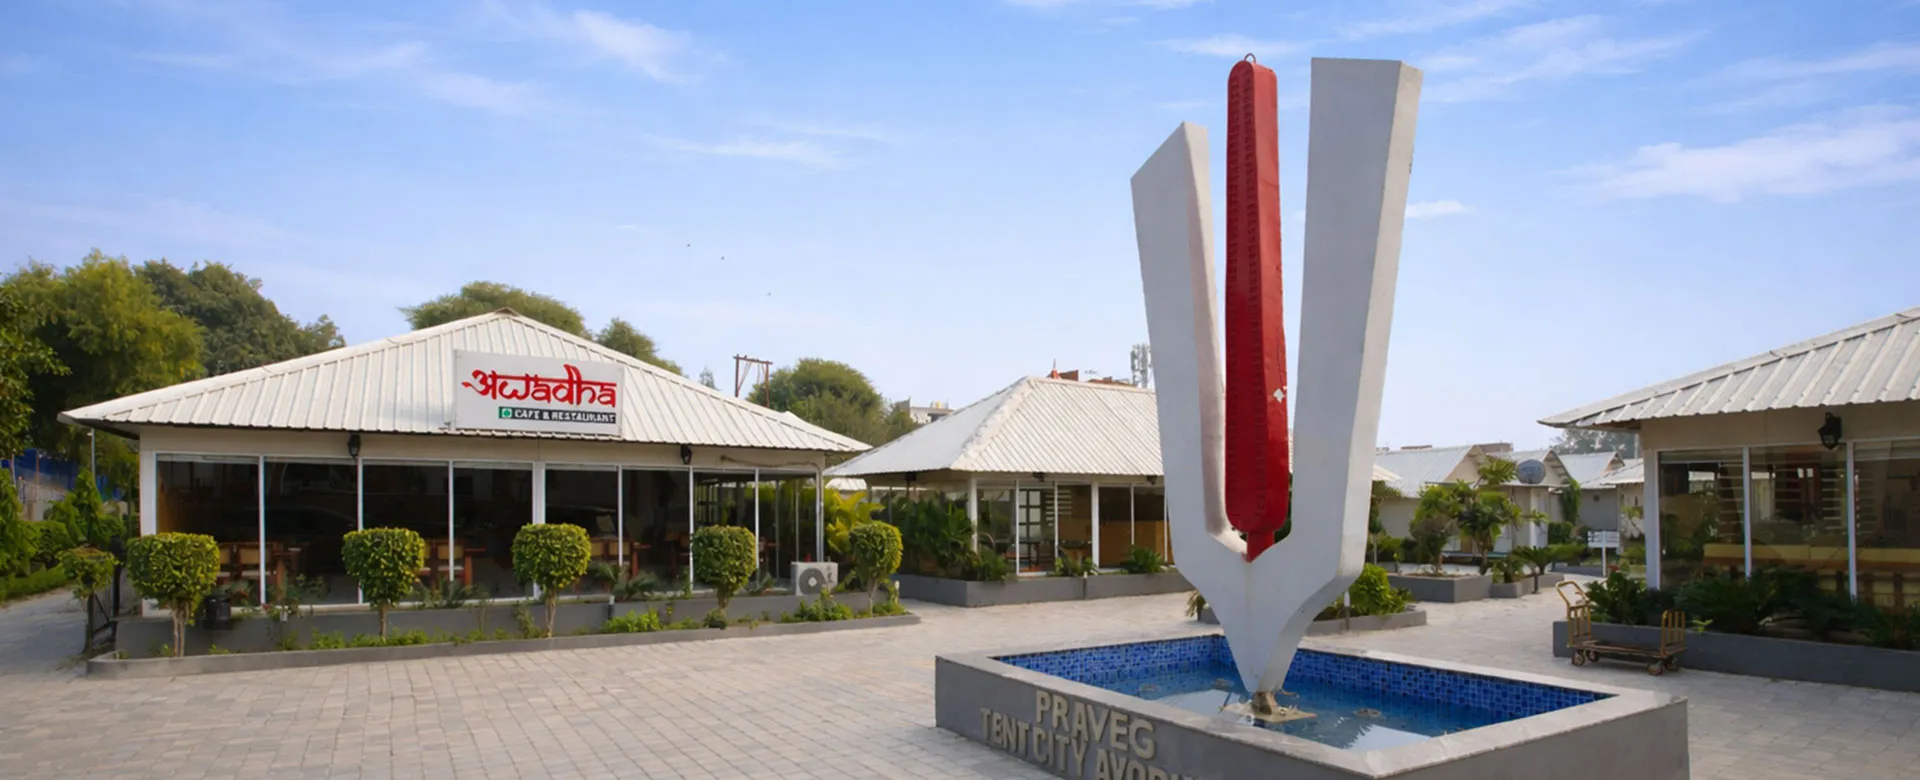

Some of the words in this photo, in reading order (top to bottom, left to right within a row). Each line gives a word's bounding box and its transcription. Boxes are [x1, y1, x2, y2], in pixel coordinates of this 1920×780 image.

[514, 407, 540, 419] CAFE
[551, 411, 616, 423] RESTAURANT
[980, 707, 1029, 757] TENT
[1033, 726, 1088, 778] CITY
[1036, 690, 1156, 760] PRAVEG
